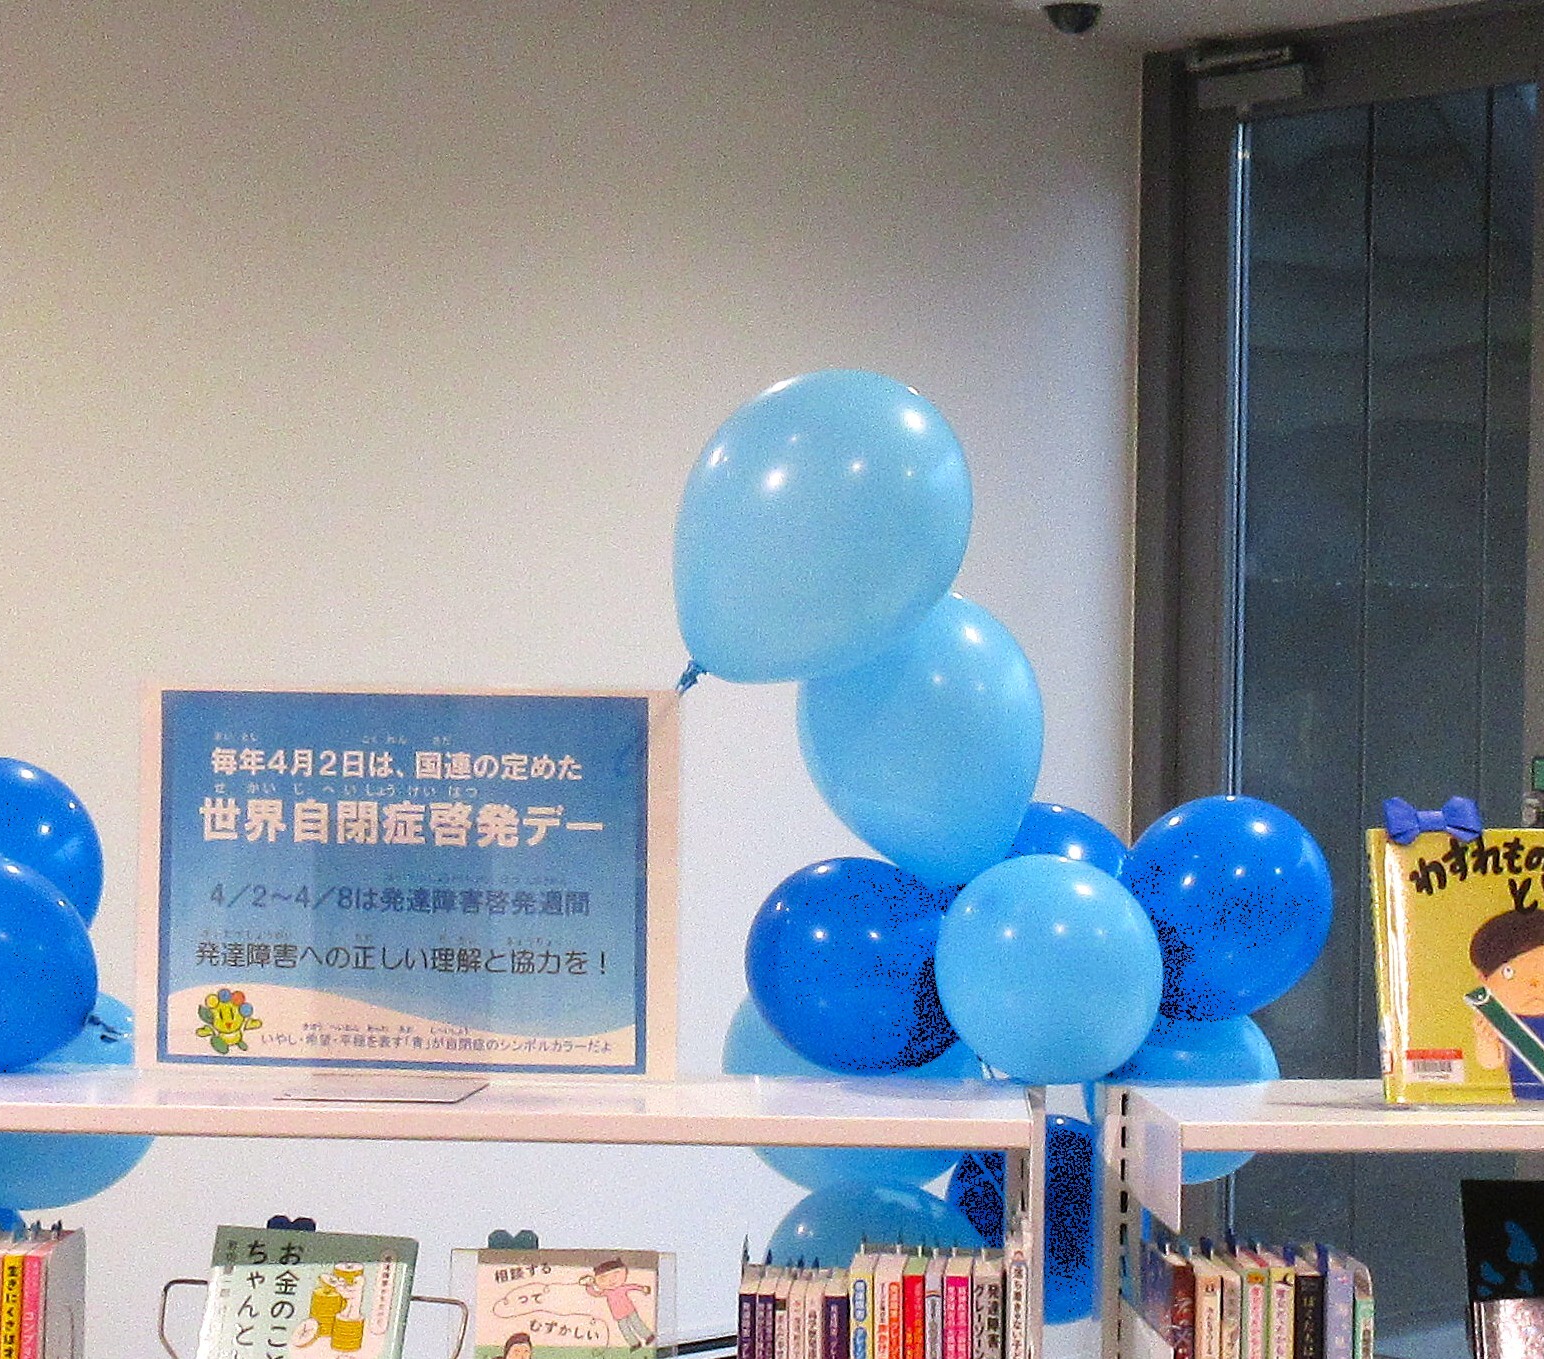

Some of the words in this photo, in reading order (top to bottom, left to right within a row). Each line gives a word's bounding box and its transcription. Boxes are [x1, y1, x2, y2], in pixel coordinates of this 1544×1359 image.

[211, 746, 583, 781] 毎年4月2日は、国連の定めた
[198, 799, 604, 848] 世界自閉症啓発デー
[495, 1262, 553, 1284] 相談する
[517, 1292, 543, 1306] って
[529, 1318, 602, 1342] むずかしい
